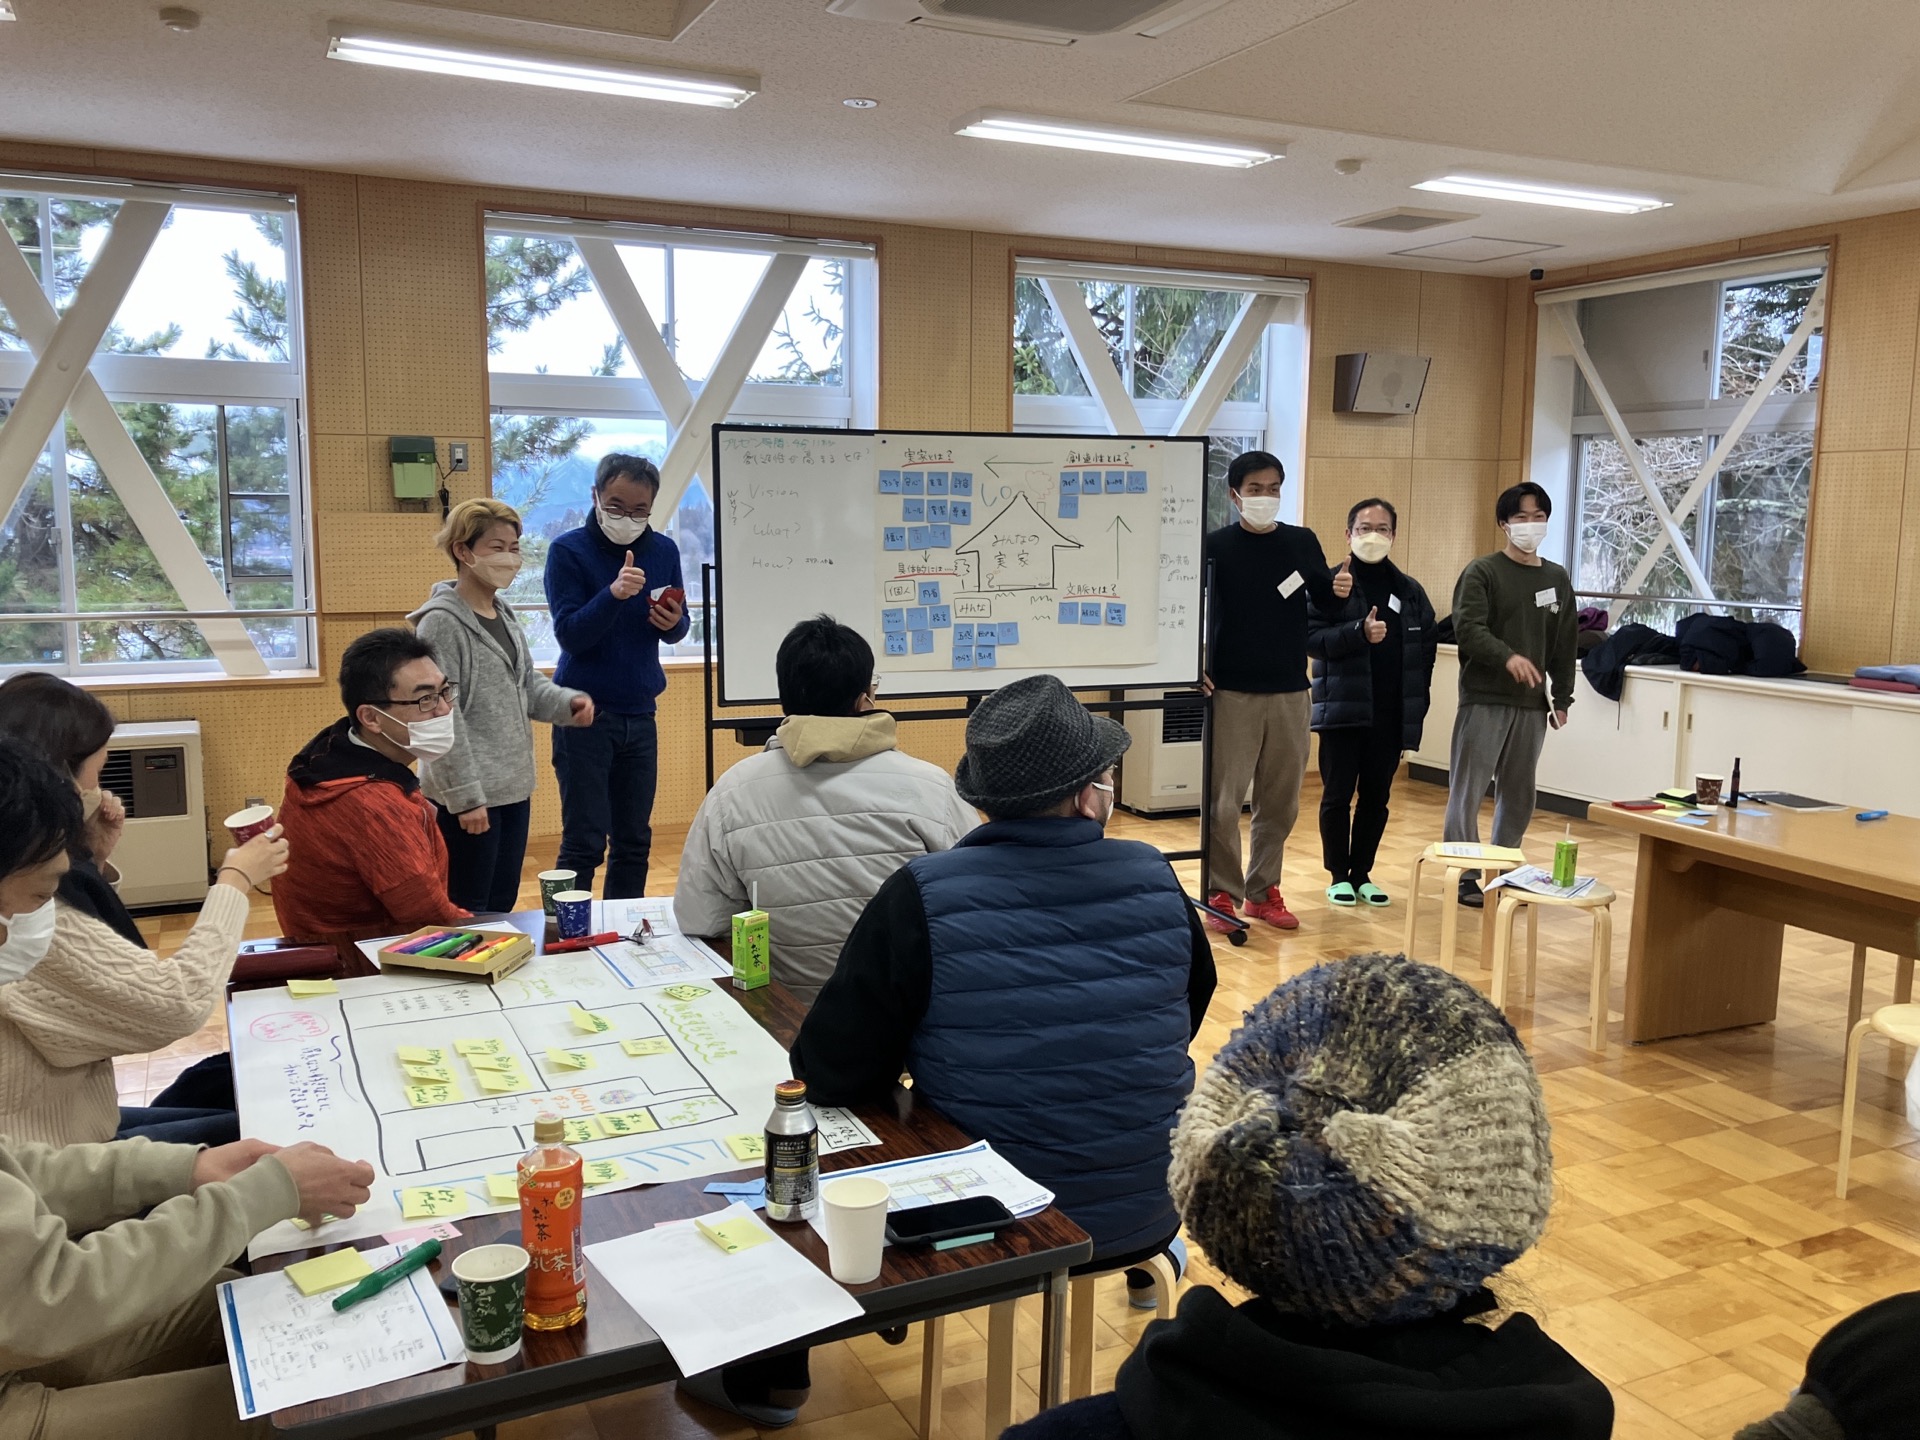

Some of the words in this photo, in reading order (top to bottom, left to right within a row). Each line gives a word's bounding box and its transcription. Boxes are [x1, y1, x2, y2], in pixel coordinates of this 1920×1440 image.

[749, 483, 799, 499] Vision
[904, 506, 923, 514] ルール
[991, 535, 1040, 547] みんなの
[752, 556, 793, 570] How?
[994, 549, 1030, 569] 実家
[889, 585, 911, 597] 個人
[959, 604, 987, 614] みんな
[568, 1087, 596, 1113] KOKU
[528, 1253, 572, 1273] うじ茶
